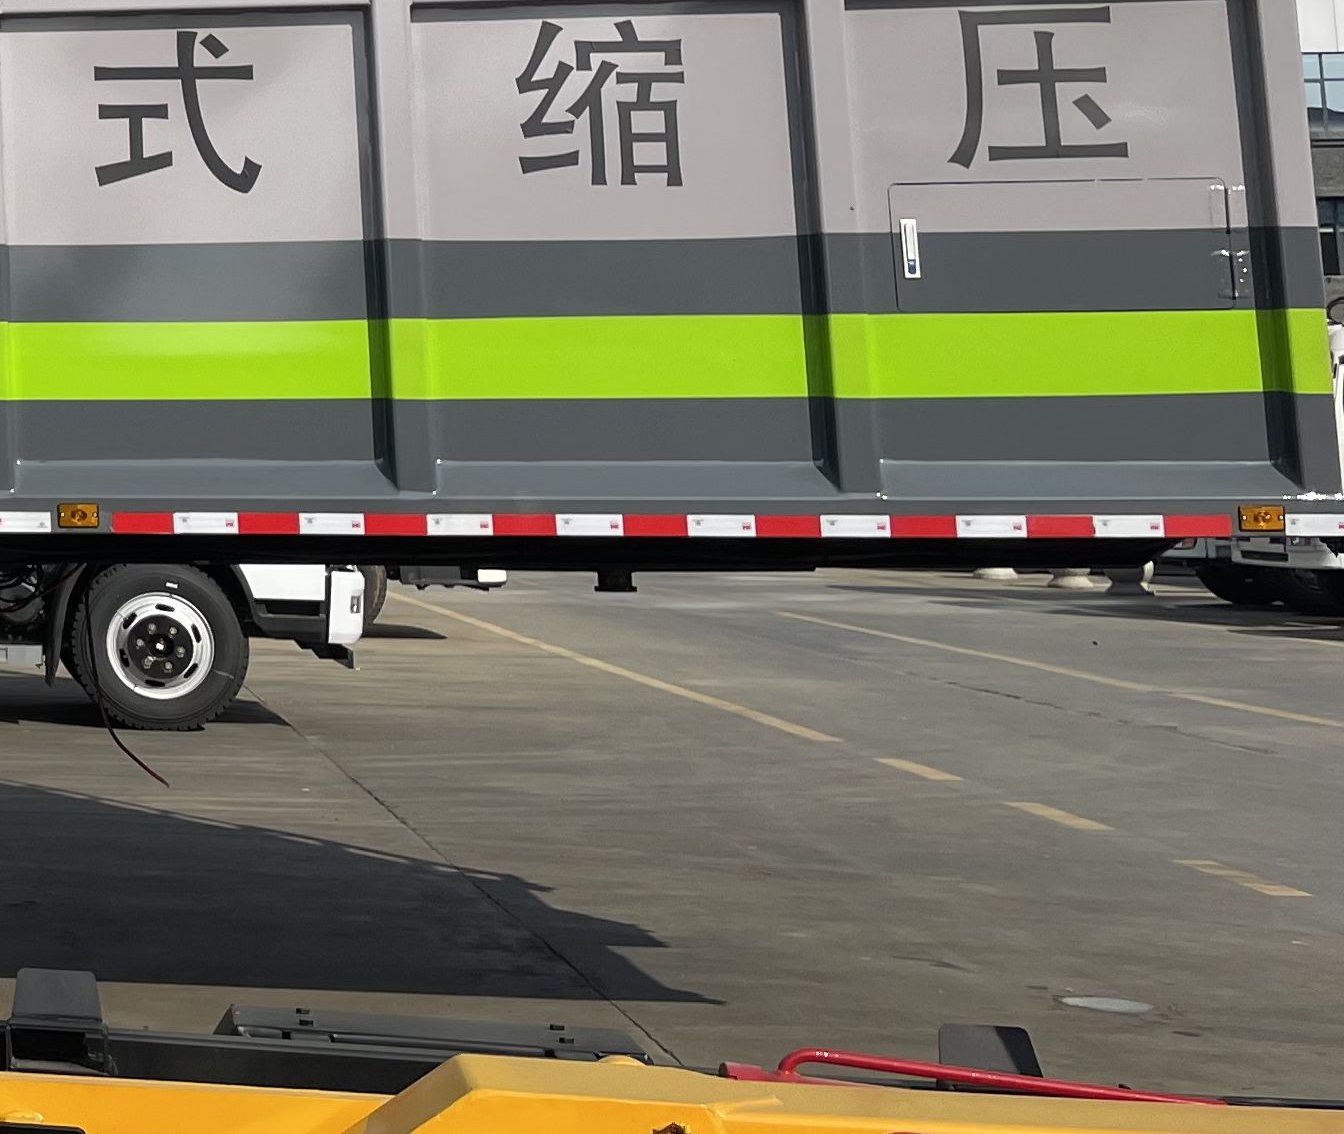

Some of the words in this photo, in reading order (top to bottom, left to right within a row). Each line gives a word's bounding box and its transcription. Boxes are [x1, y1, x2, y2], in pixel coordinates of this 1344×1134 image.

[94, 31, 261, 193] 式
[516, 21, 684, 186] 缩
[949, 6, 1128, 168] 压
